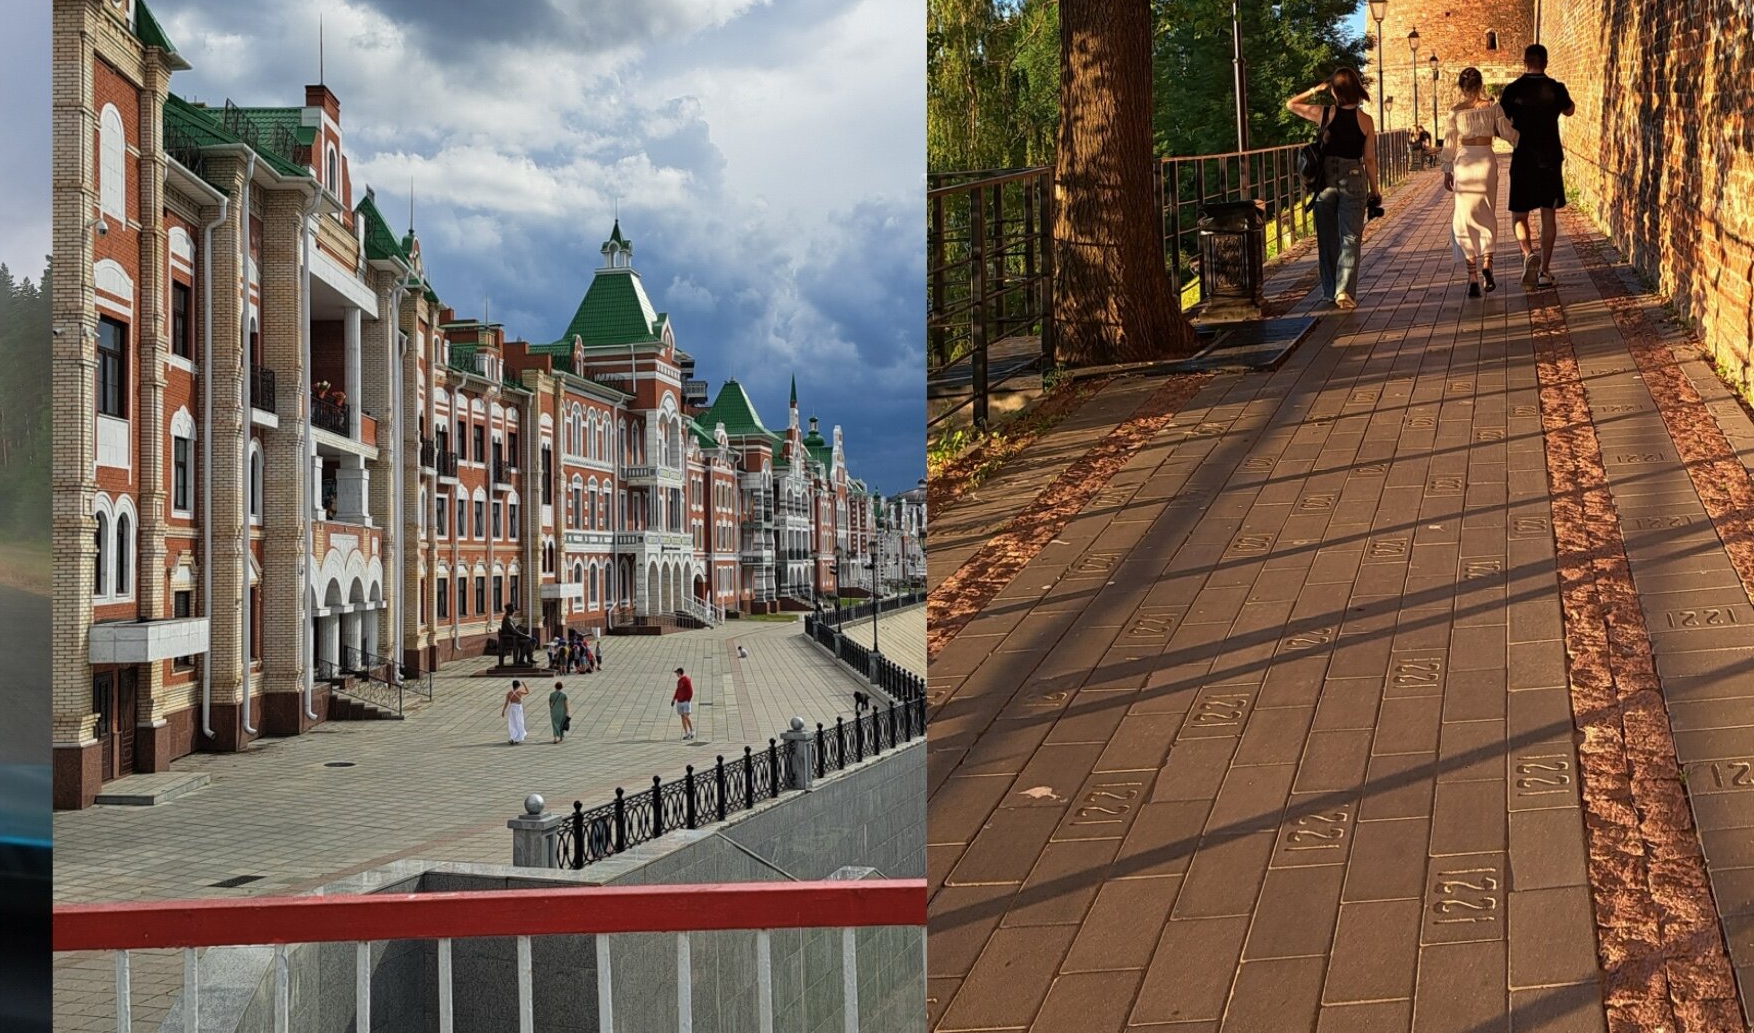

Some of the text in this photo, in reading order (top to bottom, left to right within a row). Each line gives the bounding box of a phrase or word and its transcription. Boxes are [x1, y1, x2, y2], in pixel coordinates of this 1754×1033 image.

[1617, 452, 1667, 464] 1221
[1635, 515, 1695, 530] 1221
[1667, 608, 1737, 628] 1221
[1393, 657, 1442, 688] 1221
[1191, 693, 1250, 727] 1221
[1517, 754, 1571, 797] 1221
[1069, 782, 1143, 825] 1221
[1434, 867, 1498, 925] 1221
